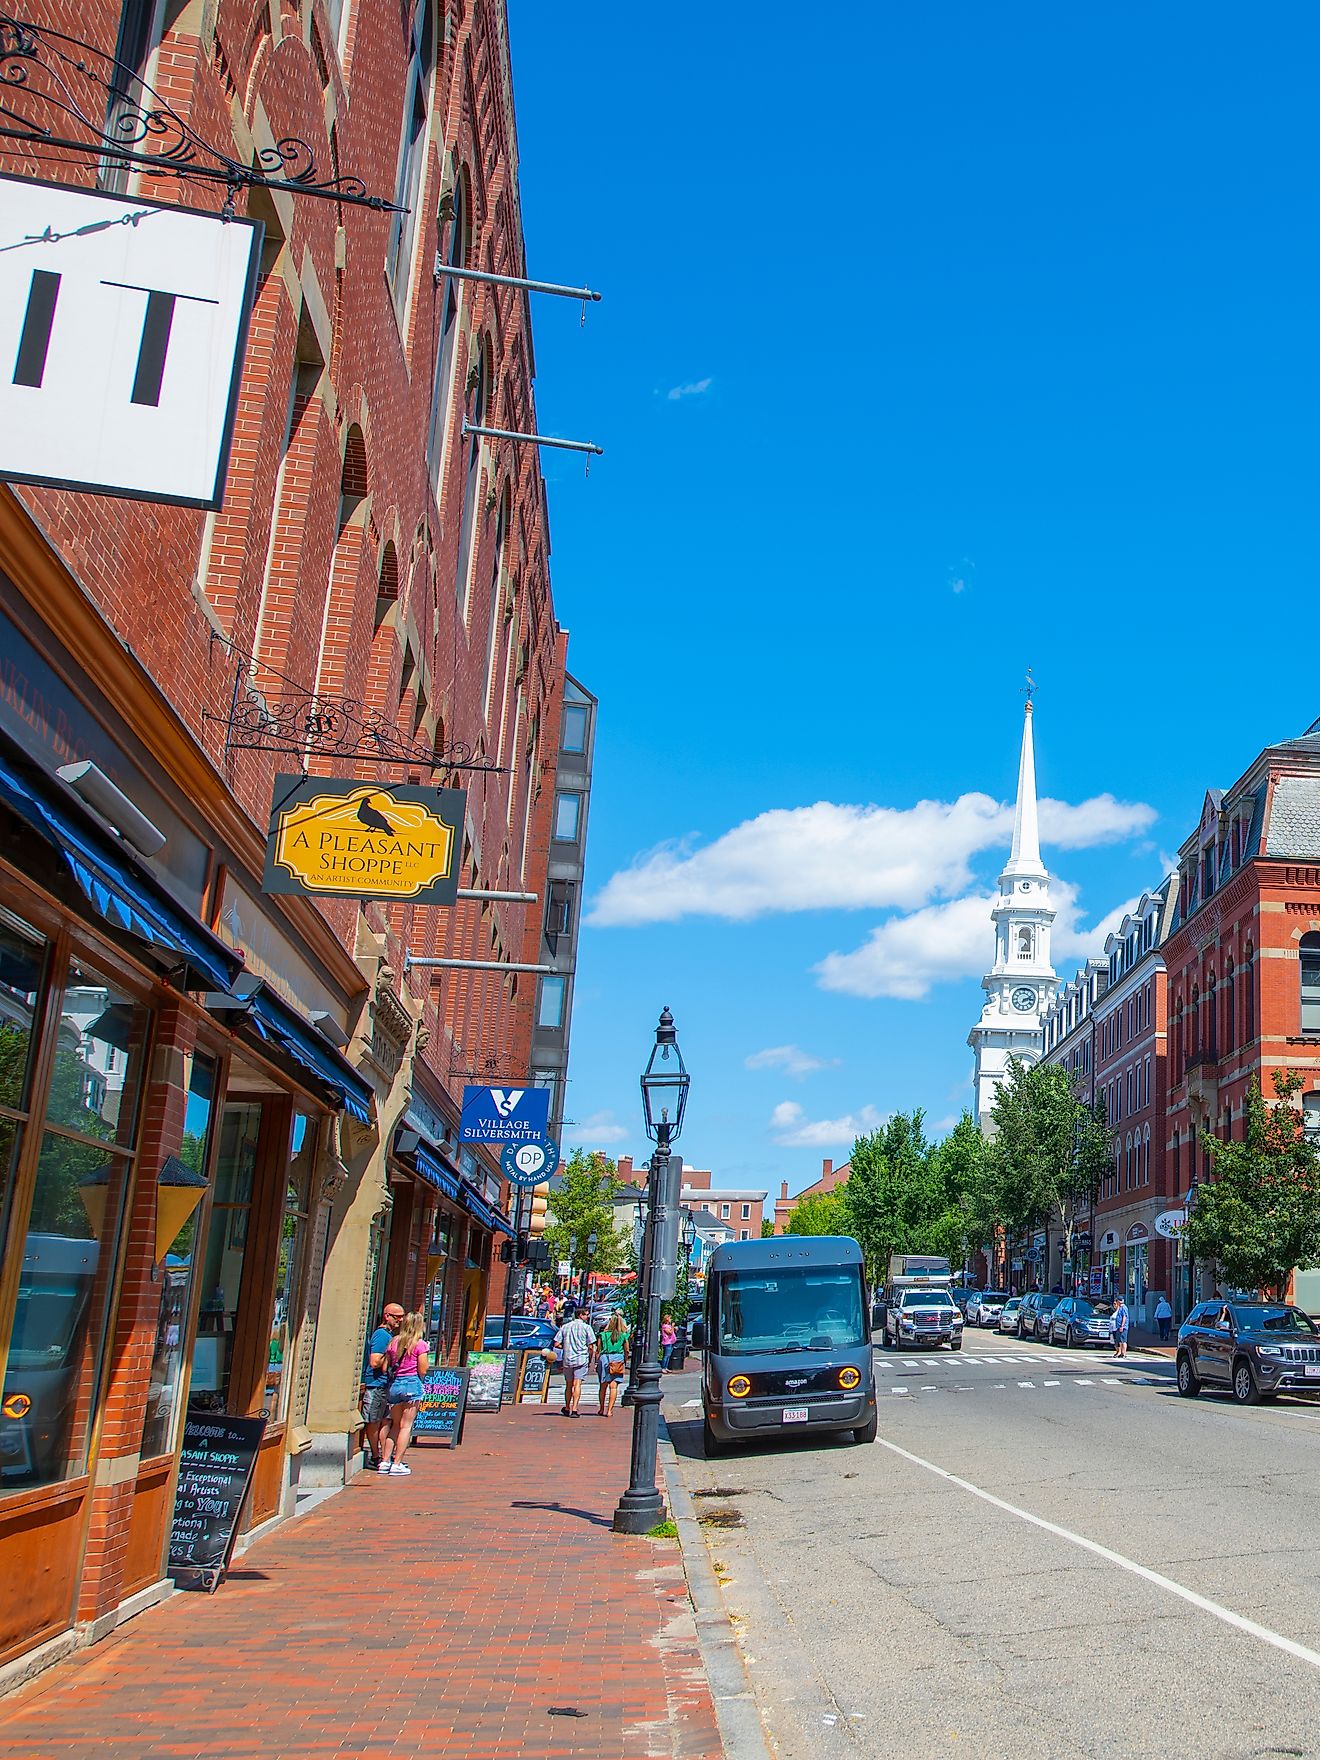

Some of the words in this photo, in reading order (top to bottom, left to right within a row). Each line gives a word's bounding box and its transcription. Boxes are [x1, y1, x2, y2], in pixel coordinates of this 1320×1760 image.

[292, 830, 310, 849] A
[319, 832, 441, 859] PLEASANT
[319, 853, 403, 875] SHOPPE
[310, 873, 324, 881] AN
[325, 875, 356, 883] ARTIST
[357, 876, 415, 888] COMMUNITY
[478, 1118, 530, 1130] VILLAGE
[463, 1127, 541, 1140] SILVERSMITH
[520, 1152, 542, 1164] DP
[505, 1160, 518, 1179] METAL
[528, 1172, 546, 1182] HAND
[525, 1371, 546, 1383] OPEN
[785, 1378, 808, 1387] amazon
[198, 1438, 208, 1448] A
[181, 1449, 209, 1461] ASANT
[210, 1451, 240, 1465] SHOPPE
[185, 1470, 232, 1486] Exceptional
[190, 1482, 220, 1497] Artists
[184, 1499, 194, 1508] to
